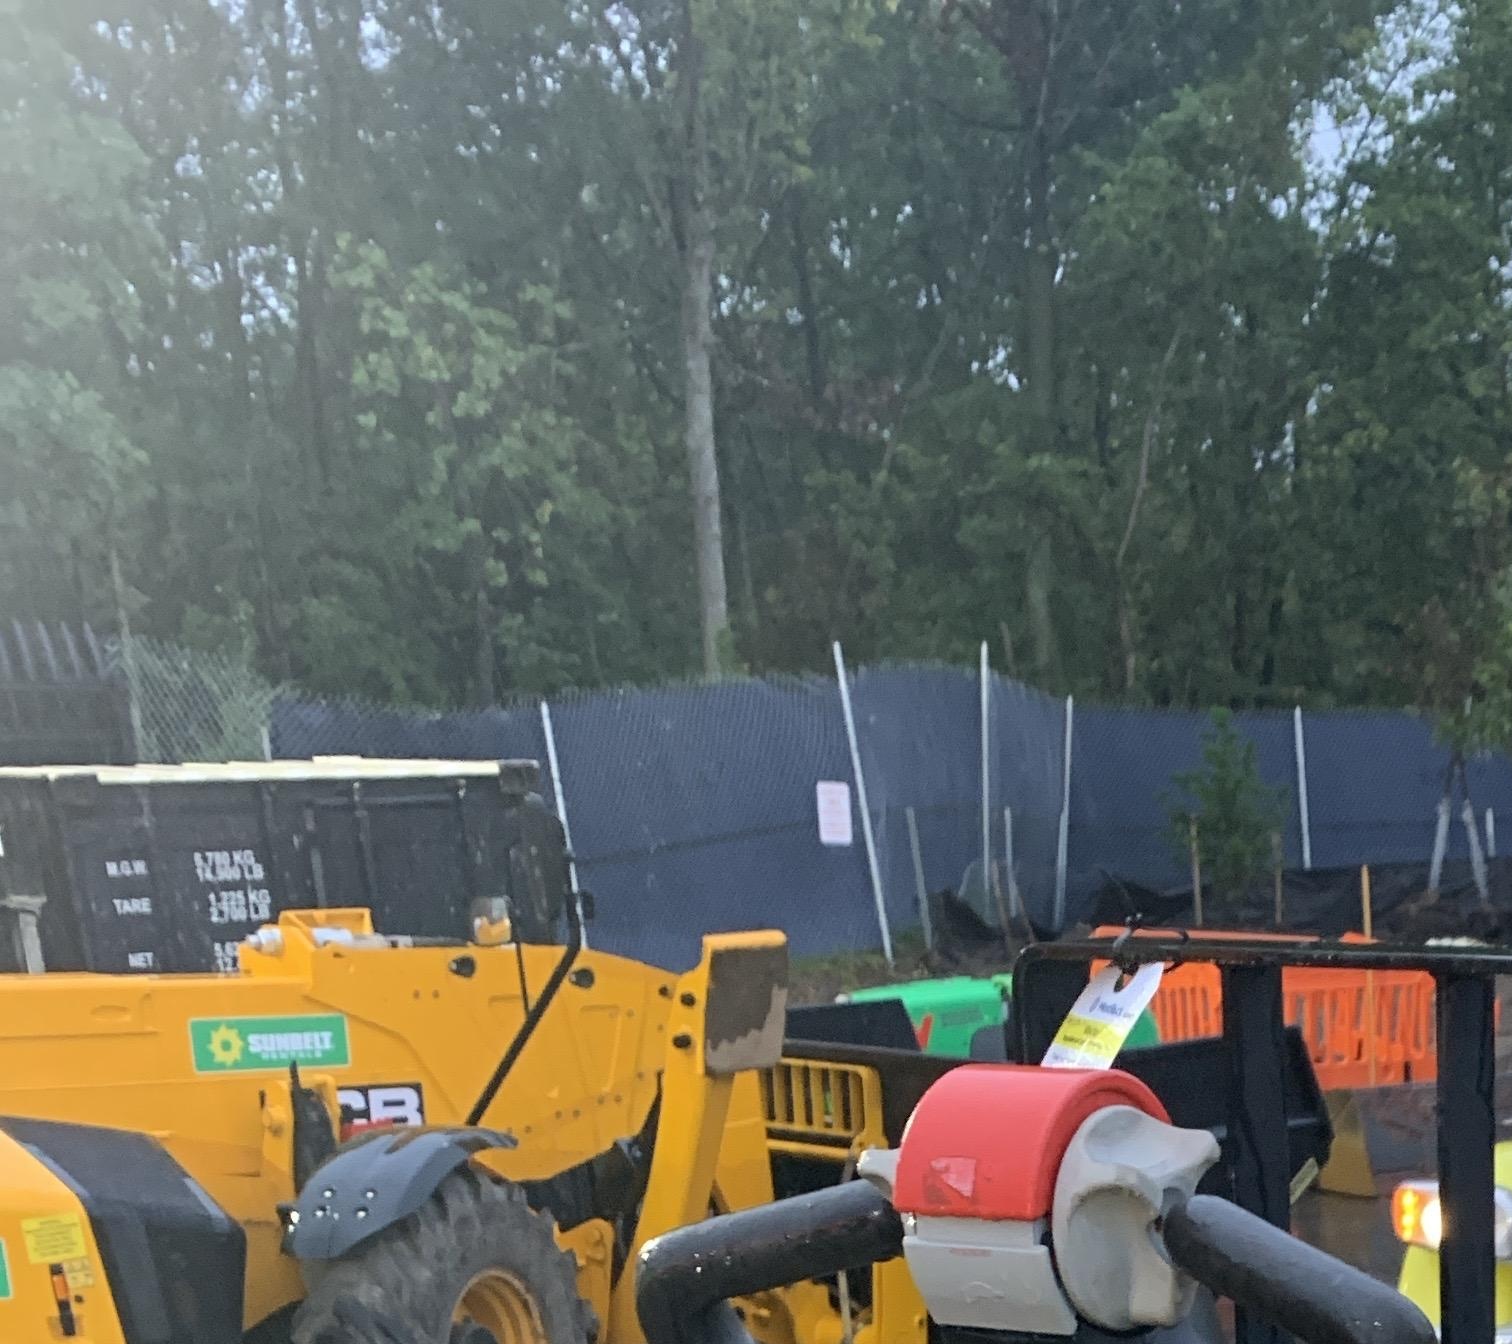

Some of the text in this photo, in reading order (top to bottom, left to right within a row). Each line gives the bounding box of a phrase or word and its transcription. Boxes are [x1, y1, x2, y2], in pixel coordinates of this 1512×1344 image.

[113, 897, 152, 915] TARE
[129, 952, 153, 968] NET
[247, 1032, 333, 1052] SUNBELT
[337, 1087, 423, 1126] CB
